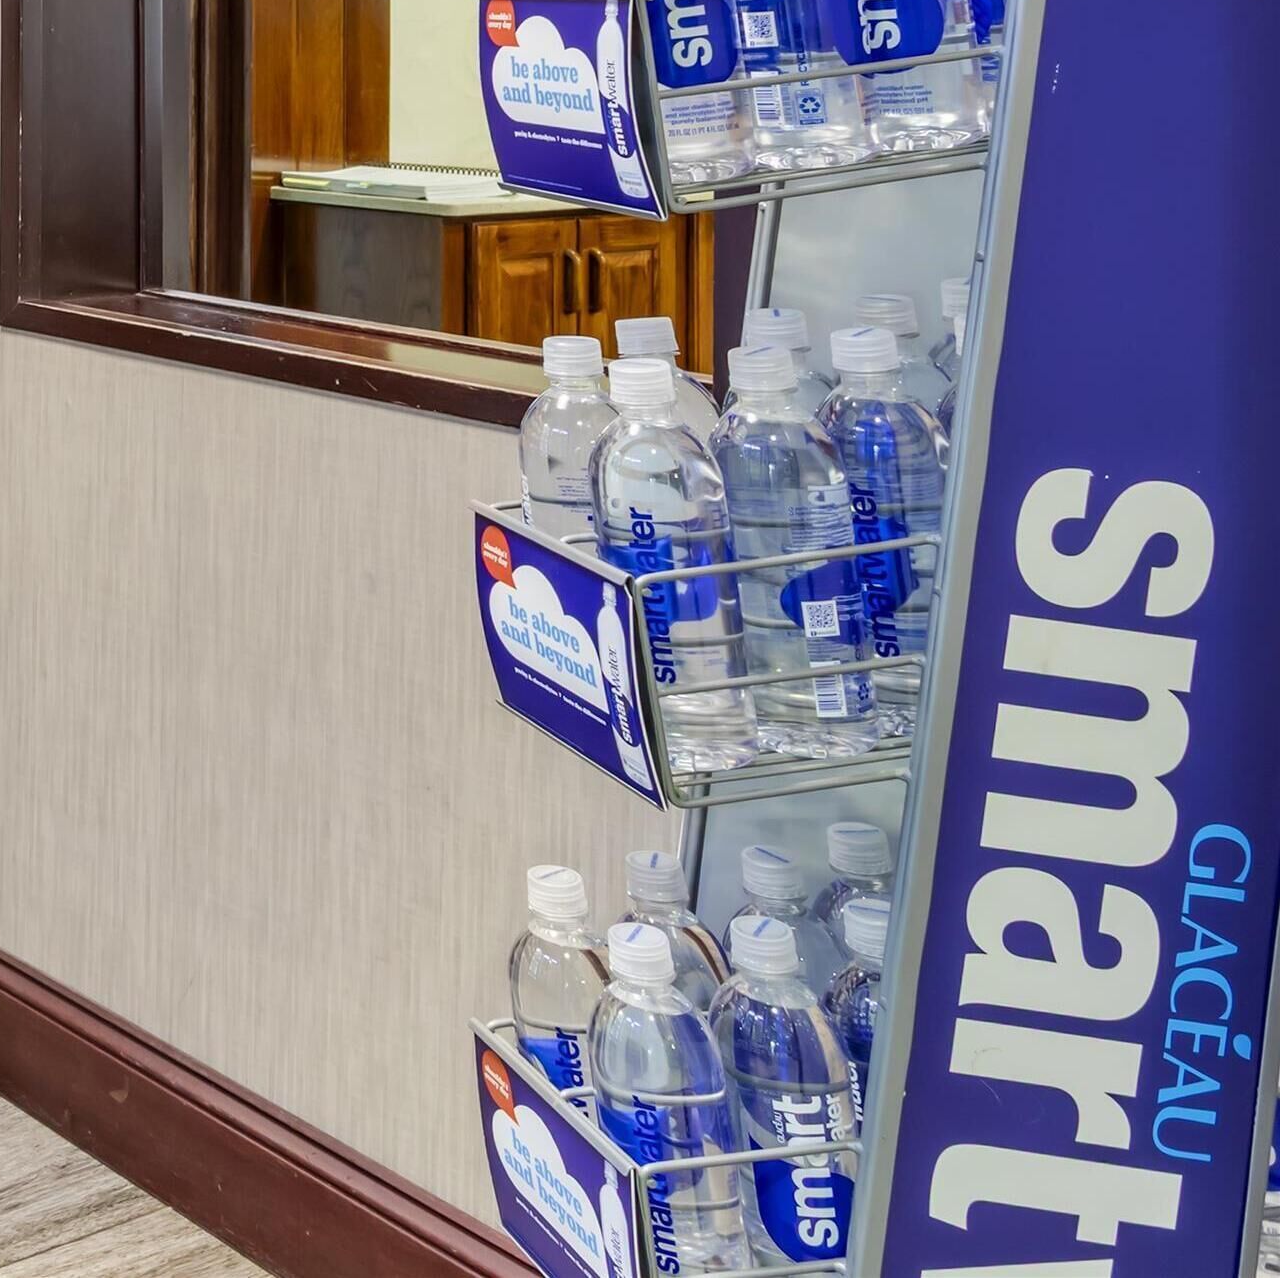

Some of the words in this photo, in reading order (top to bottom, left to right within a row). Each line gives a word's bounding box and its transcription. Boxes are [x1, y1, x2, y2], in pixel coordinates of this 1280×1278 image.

[502, 21, 512, 30] day
[510, 55, 530, 78] be
[533, 58, 579, 84] above
[503, 82, 532, 104] and
[534, 83, 595, 113] beyond
[606, 59, 629, 157] smartwater
[501, 619, 532, 650] and
[535, 632, 598, 689] beyond
[508, 595, 529, 622] be
[532, 608, 580, 654] above
[608, 647, 634, 745] smartwater
[920, 466, 1216, 1278] smart
[1152, 822, 1254, 1164] GLACÉAU
[504, 1147, 534, 1192] and
[538, 1180, 600, 1258] beyond
[511, 1128, 531, 1158] be
[535, 1156, 583, 1218] above
[771, 1094, 840, 1249] smart
